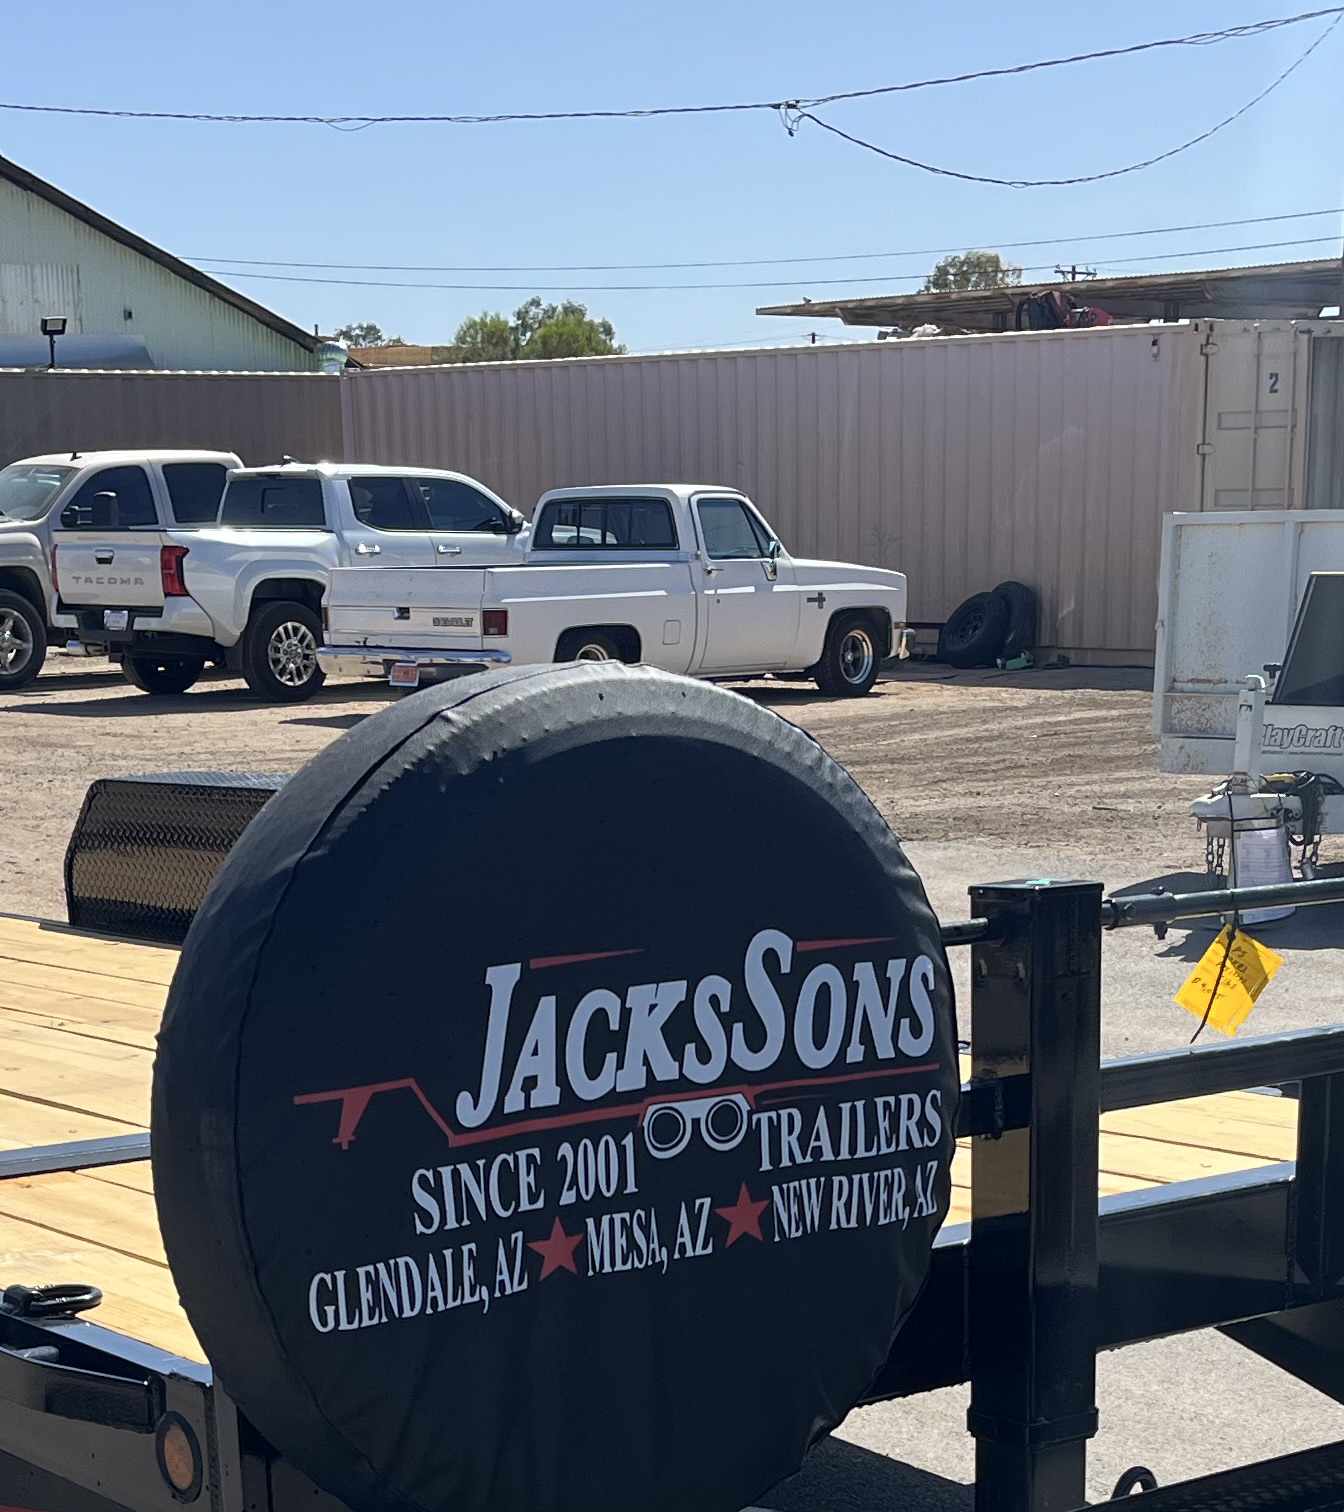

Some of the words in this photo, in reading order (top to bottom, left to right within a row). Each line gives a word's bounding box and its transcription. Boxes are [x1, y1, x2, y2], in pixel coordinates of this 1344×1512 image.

[1269, 373, 1279, 394] 2
[72, 576, 144, 586] TACOMA
[1262, 724, 1344, 749] layCraft
[752, 1089, 943, 1172] TRAILERS
[411, 1147, 545, 1236] SINCE
[556, 1131, 639, 1206] 2001
[308, 1242, 490, 1333] GLENDALE,
[493, 1230, 529, 1299] AZ
[585, 1206, 668, 1277] MESA,
[673, 1197, 713, 1260] AZ
[771, 1175, 826, 1243] NEW
[828, 1165, 911, 1232] RIVER,
[913, 1160, 939, 1219] AZ
